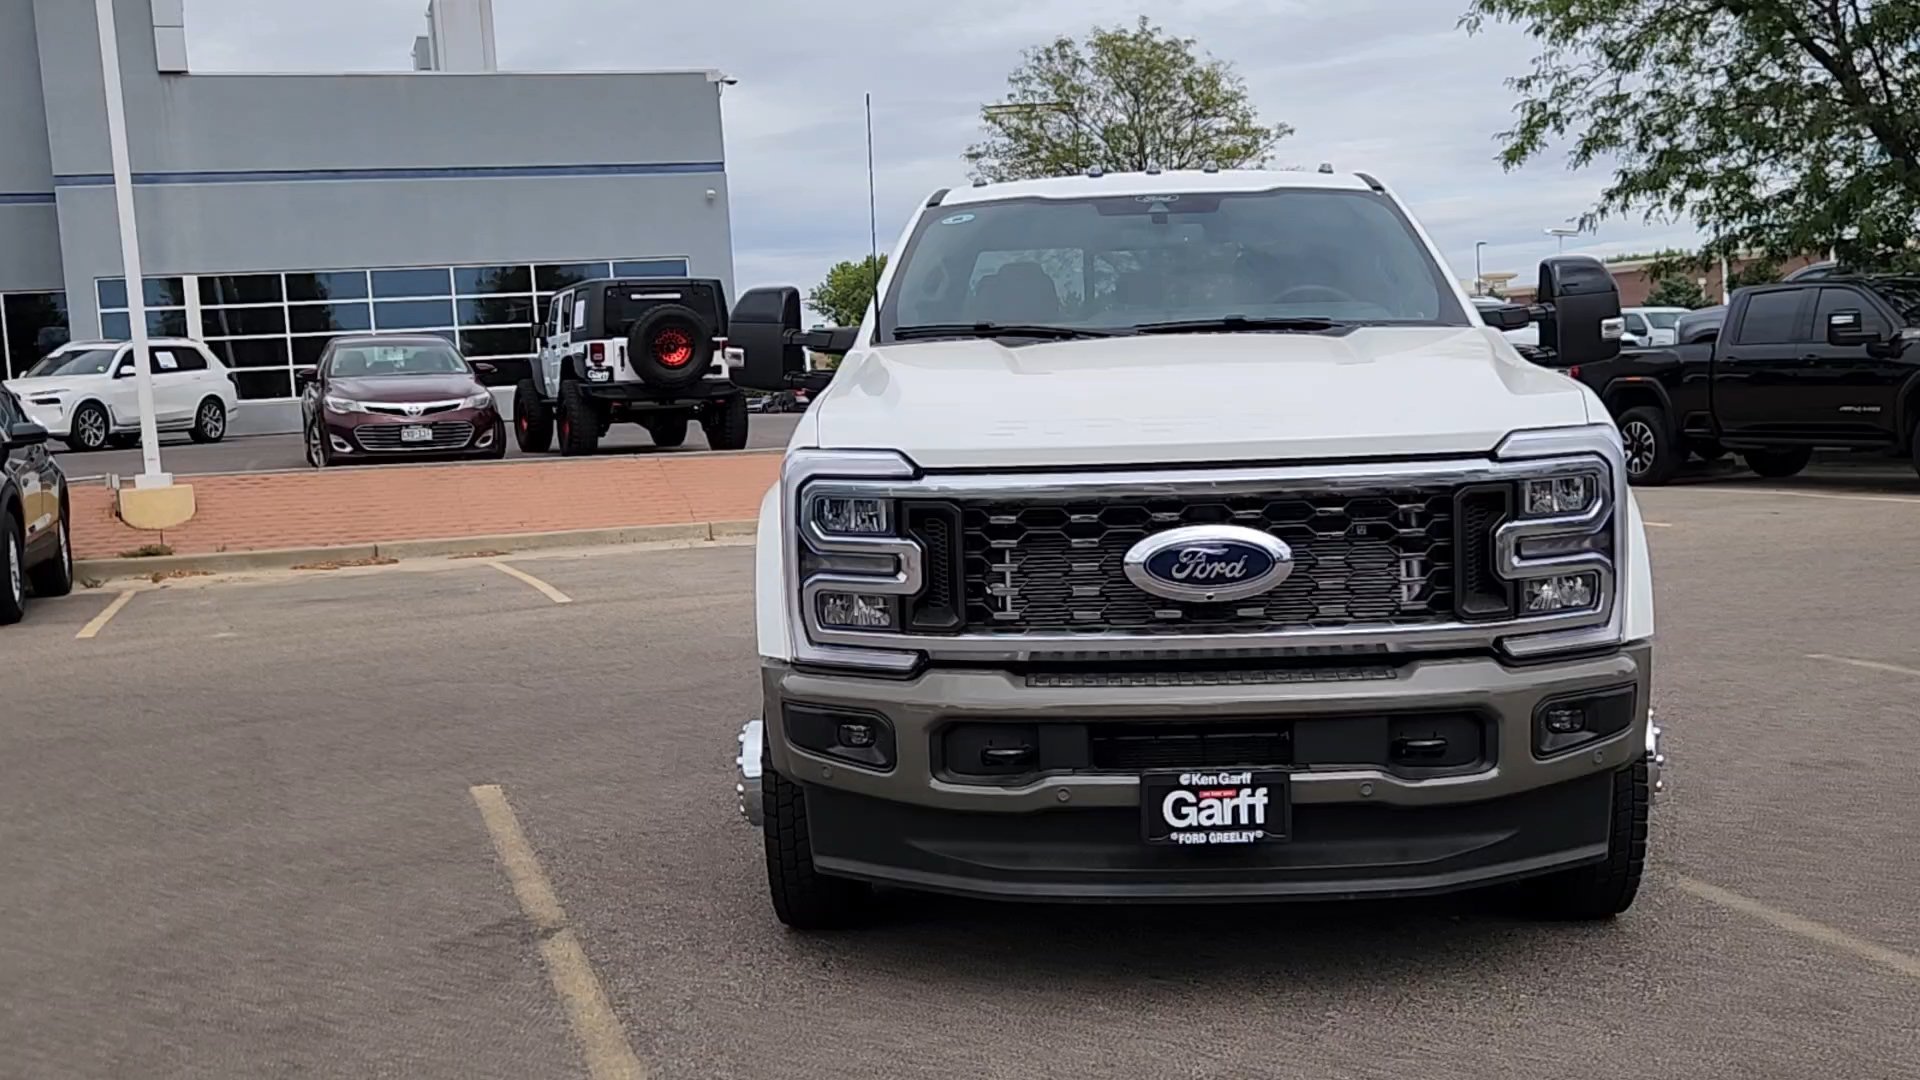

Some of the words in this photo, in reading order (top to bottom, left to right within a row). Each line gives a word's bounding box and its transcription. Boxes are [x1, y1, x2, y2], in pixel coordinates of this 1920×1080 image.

[1171, 547, 1248, 579] Ford
[1191, 773, 1217, 786] Ken
[1218, 772, 1252, 785] Garff
[1162, 787, 1268, 828] Garff
[1178, 832, 1206, 844] FORD
[1208, 831, 1256, 843] GREELEY
